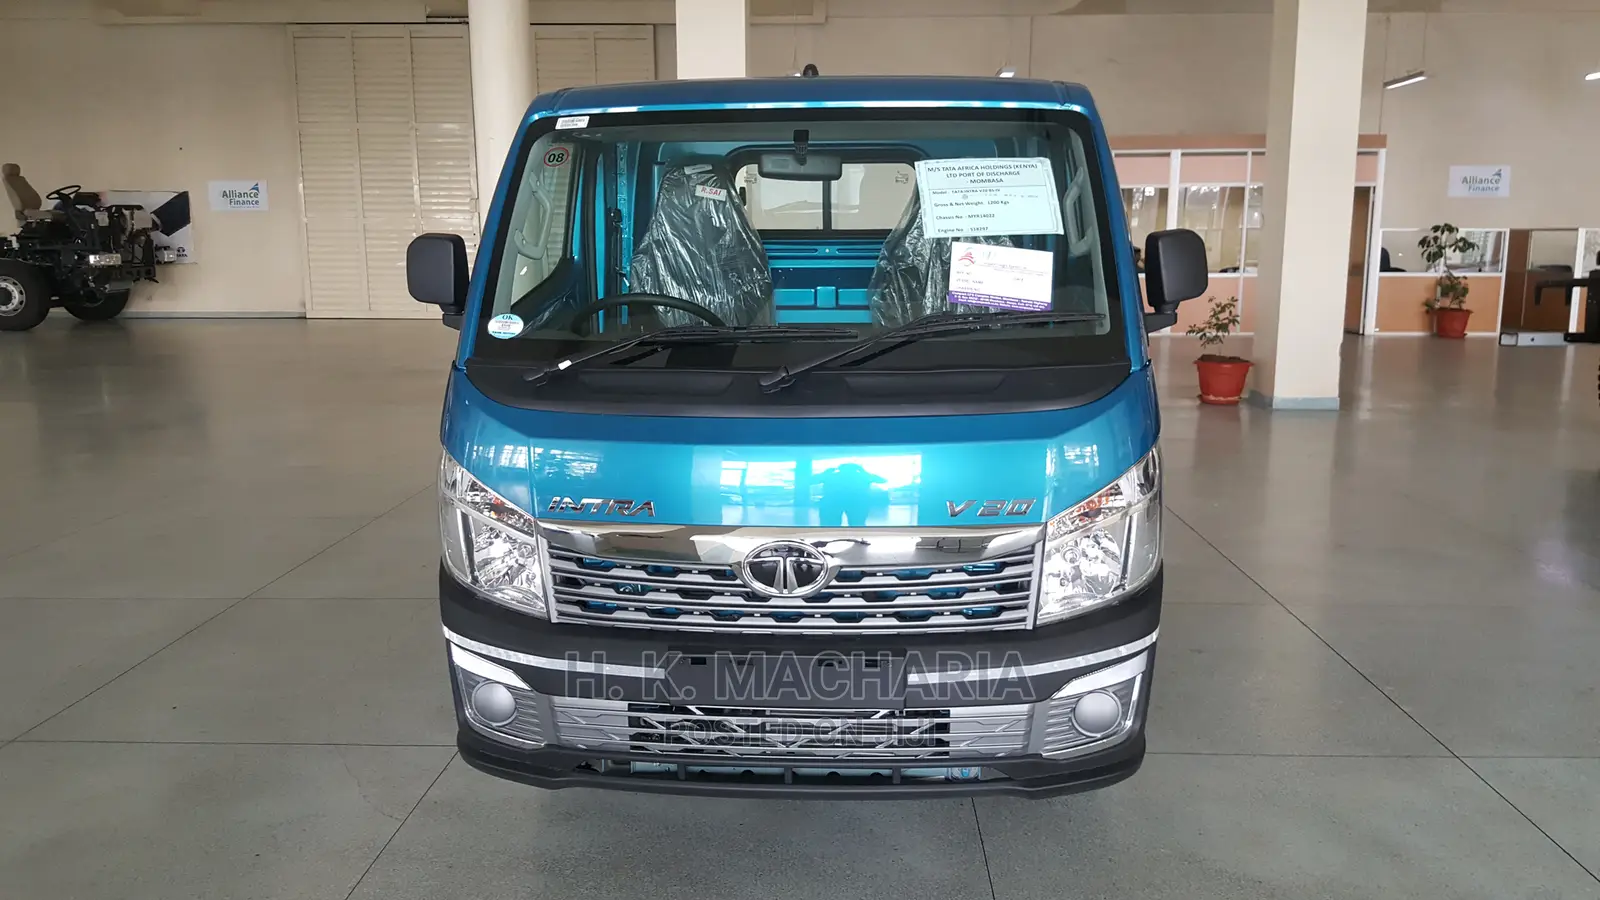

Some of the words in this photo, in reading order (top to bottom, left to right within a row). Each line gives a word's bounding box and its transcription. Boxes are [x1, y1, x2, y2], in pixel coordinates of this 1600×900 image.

[547, 152, 565, 163] 08
[1462, 176, 1500, 184] Alliance
[1468, 184, 1500, 192] Finance
[222, 190, 259, 198] Alliance
[548, 496, 656, 517] INTRA
